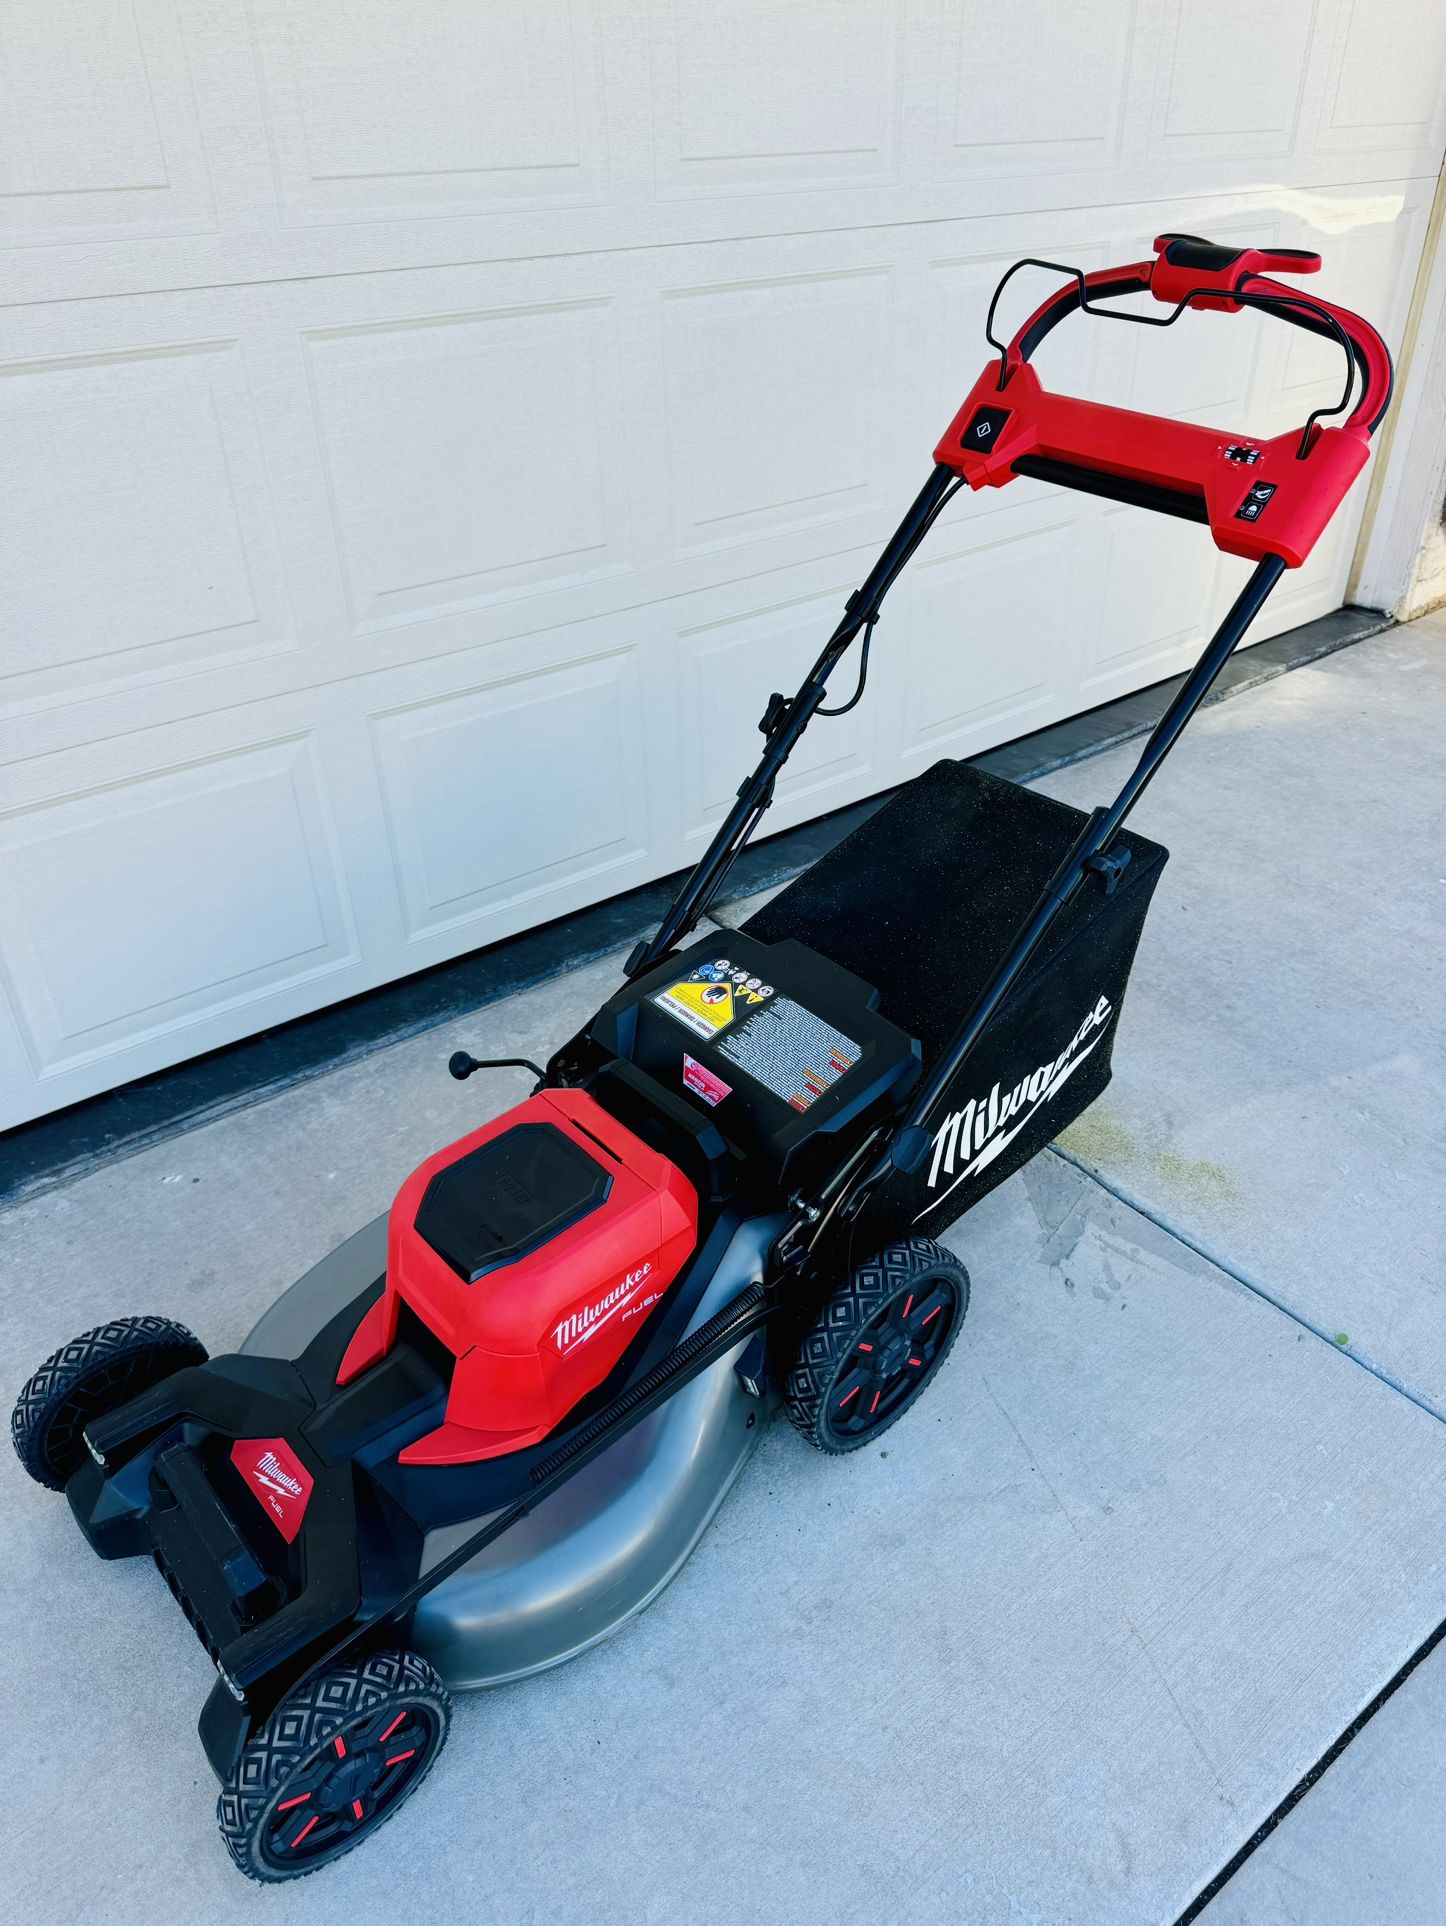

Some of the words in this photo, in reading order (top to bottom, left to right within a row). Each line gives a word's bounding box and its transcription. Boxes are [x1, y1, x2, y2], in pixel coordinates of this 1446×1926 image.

[550, 1263, 652, 1351] Milwaukee
[622, 1293, 663, 1321] FUEL
[256, 1452, 302, 1494] Milwaukee
[267, 1495, 283, 1518] FUEL
